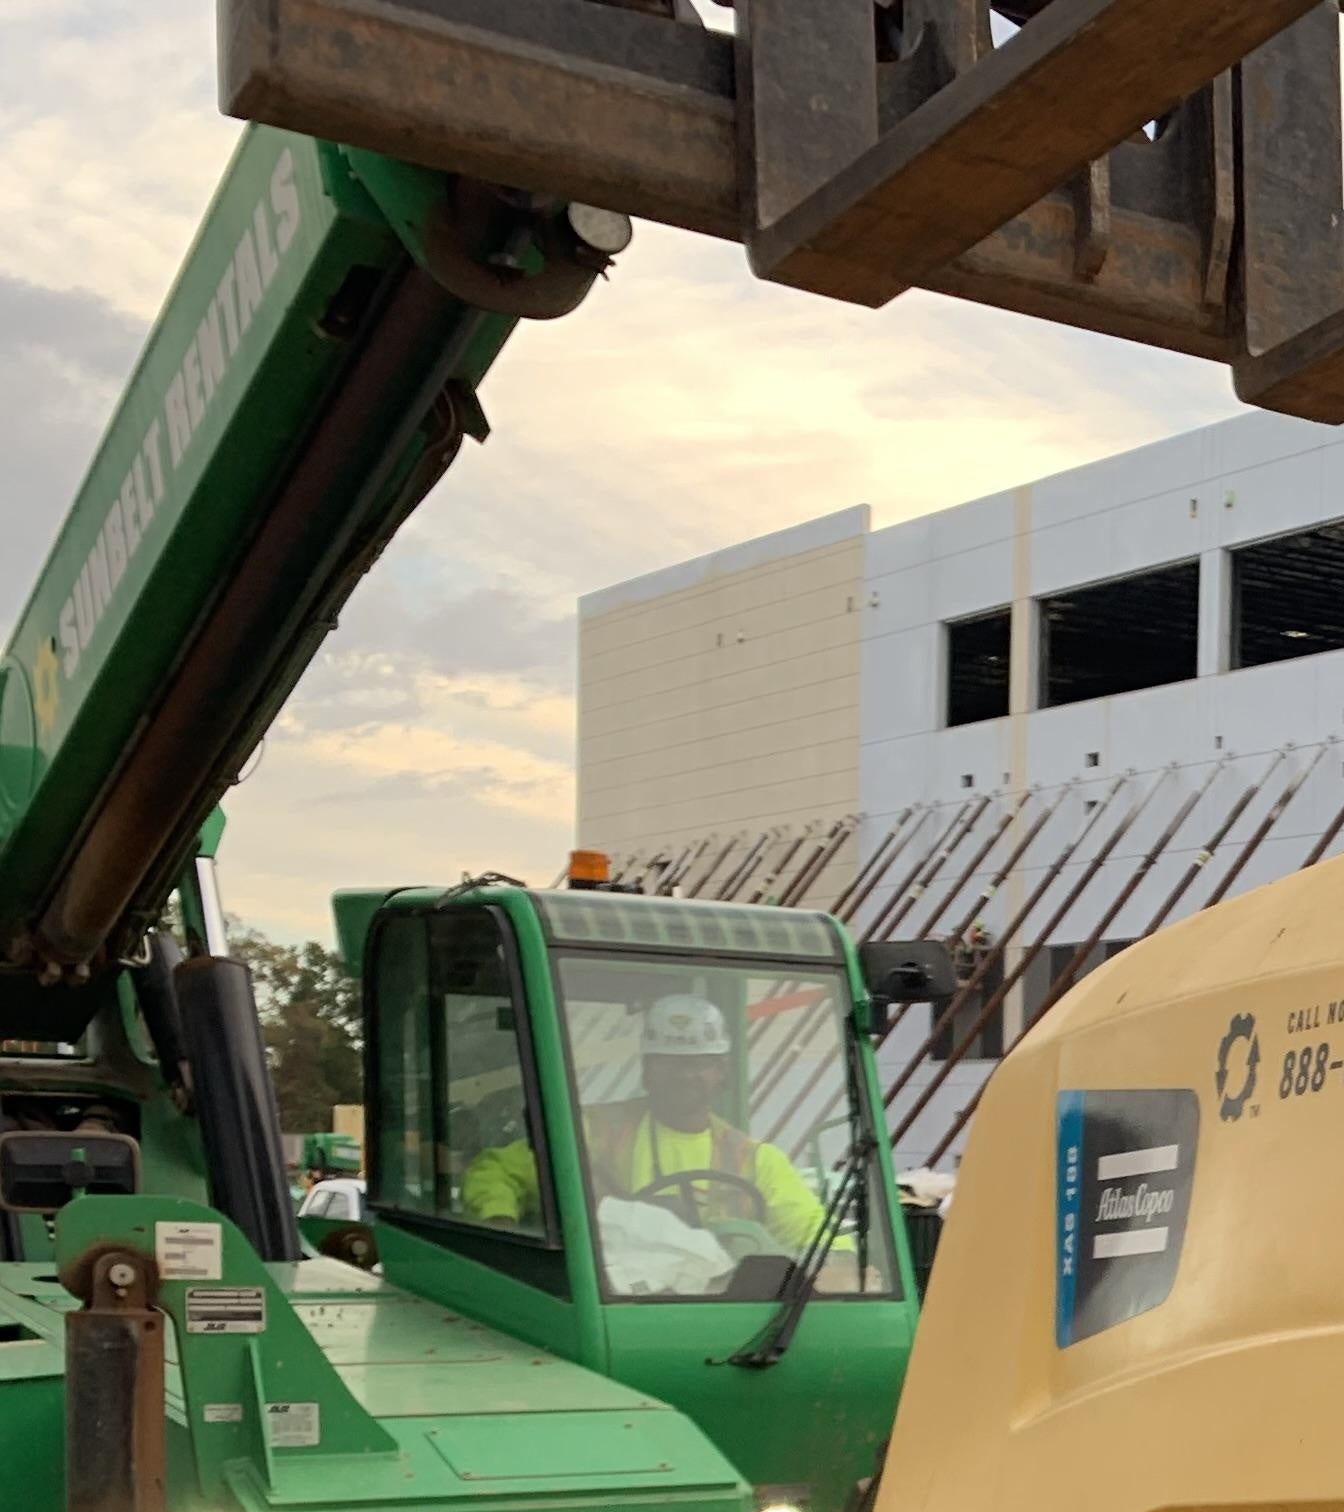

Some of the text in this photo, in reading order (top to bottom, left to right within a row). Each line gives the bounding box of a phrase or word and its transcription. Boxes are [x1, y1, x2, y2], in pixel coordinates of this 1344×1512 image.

[58, 147, 300, 681] SUNBELT RENTALS
[1287, 1005, 1320, 1034] CALL
